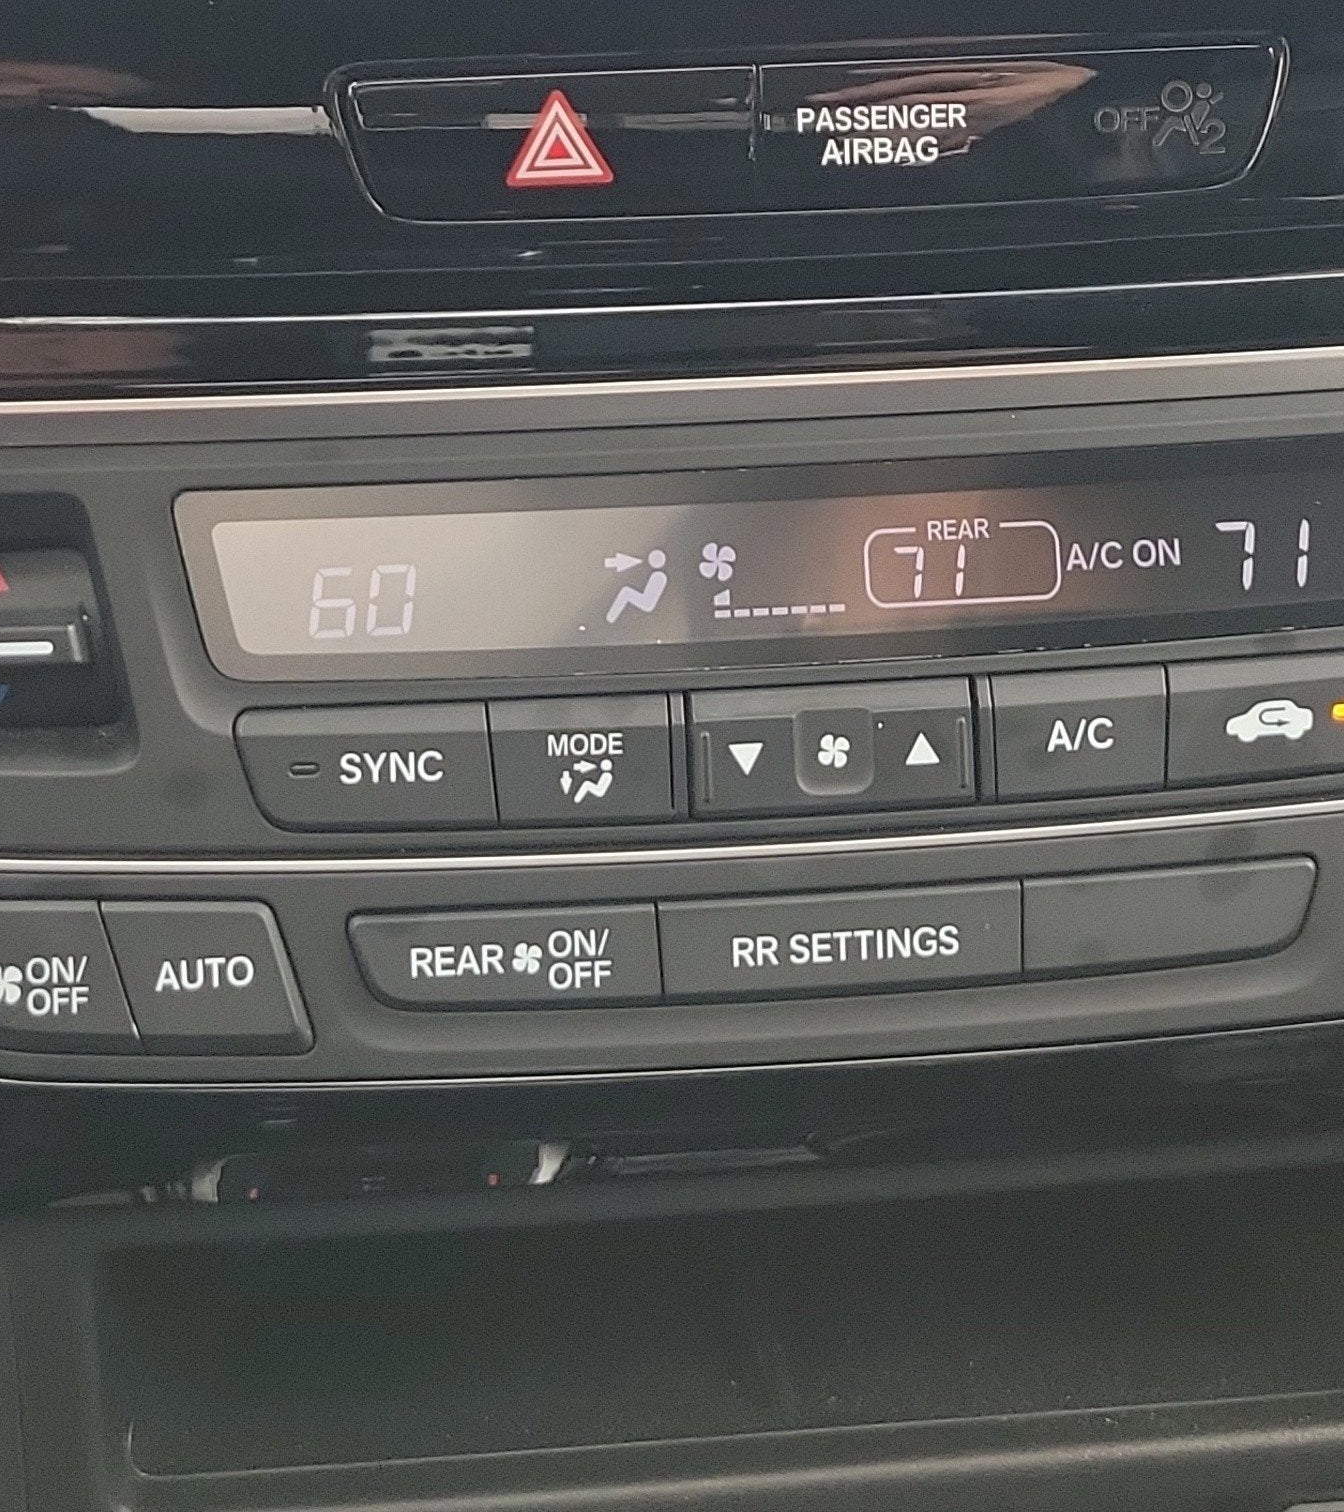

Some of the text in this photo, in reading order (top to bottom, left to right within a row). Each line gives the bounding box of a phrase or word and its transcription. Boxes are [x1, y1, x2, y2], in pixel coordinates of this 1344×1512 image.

[796, 103, 967, 133] PASSENGER
[1093, 106, 1160, 134] OFF
[820, 136, 939, 166] AIRBAG
[926, 518, 990, 541] REAR
[893, 544, 967, 599] 71
[1066, 537, 1182, 572] A/C ON
[1214, 518, 1310, 591] 71
[308, 563, 416, 640] 60
[547, 732, 624, 757] MODE
[1046, 717, 1114, 754] A/C
[338, 750, 444, 786] SYNC
[409, 928, 610, 978] REAR ON/
[731, 924, 961, 968] RR SETTINGS
[25, 955, 89, 985] ON/
[155, 955, 255, 992] AUTO
[546, 960, 613, 990] OFF
[26, 986, 90, 1017] OFF
